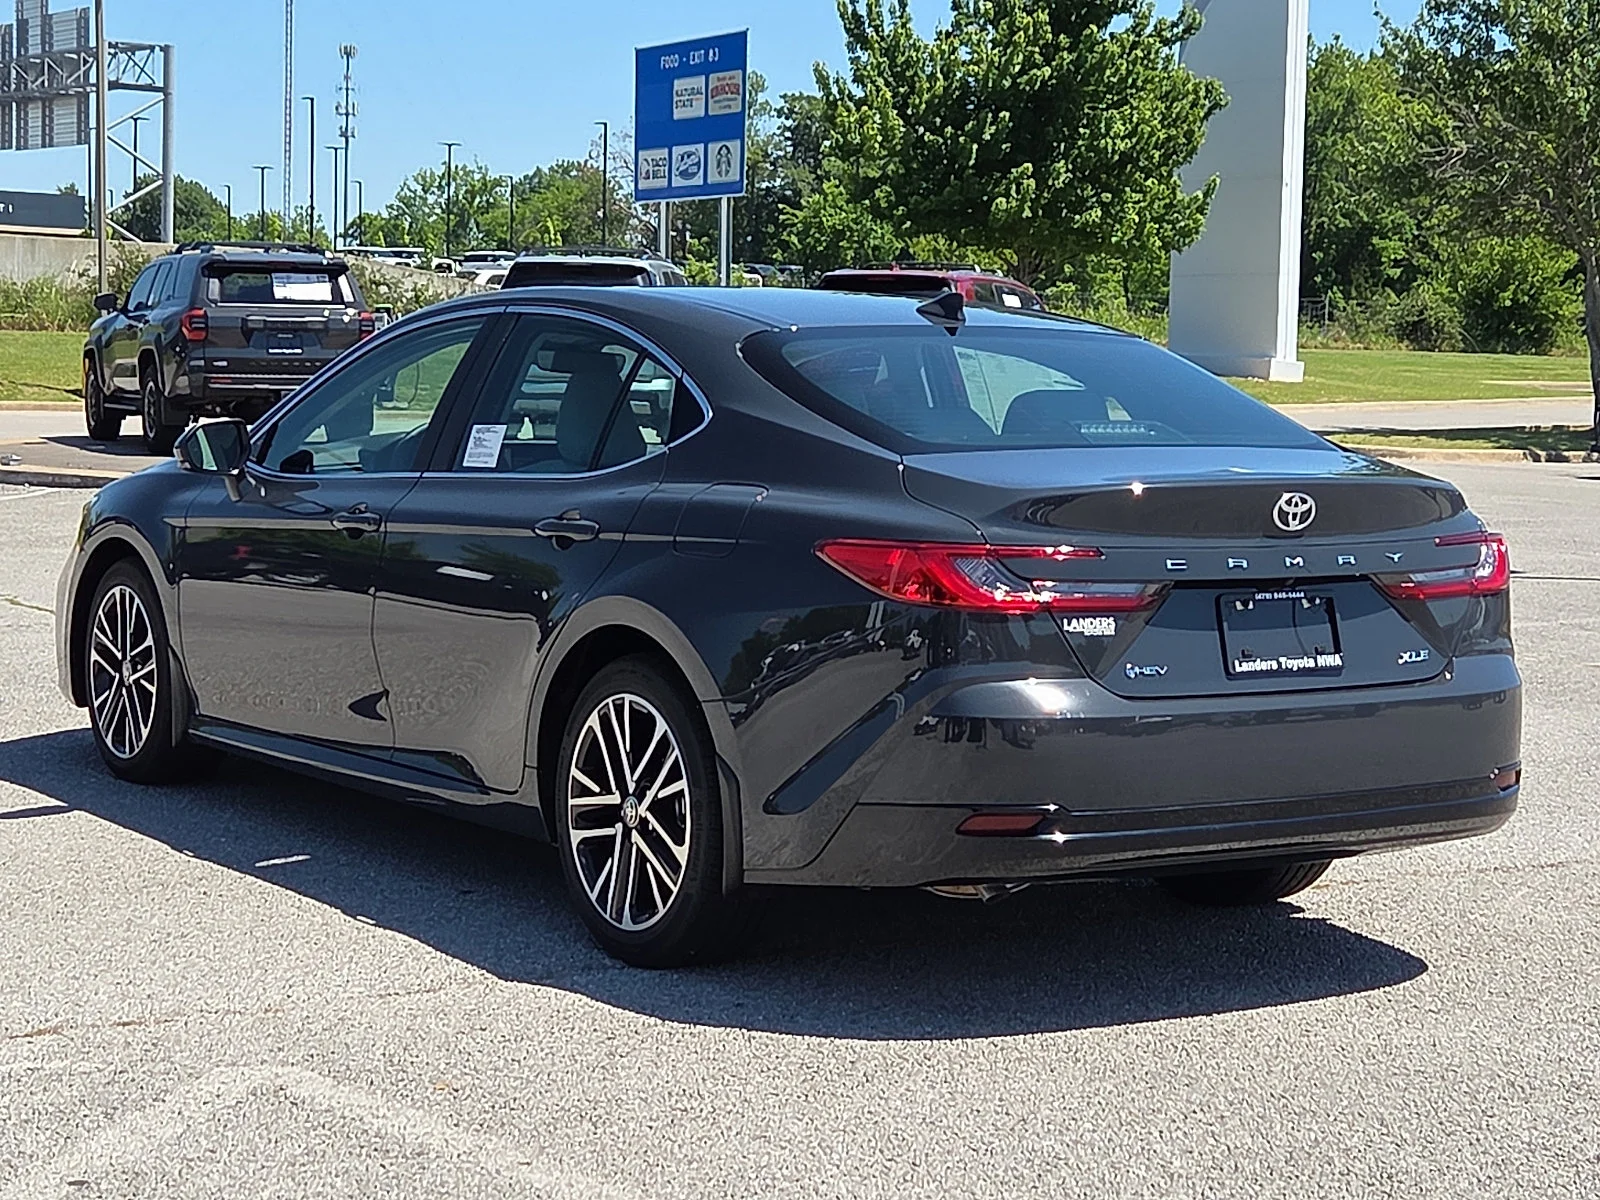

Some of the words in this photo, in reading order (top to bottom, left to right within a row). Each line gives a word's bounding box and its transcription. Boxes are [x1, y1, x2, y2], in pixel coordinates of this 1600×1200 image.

[661, 54, 679, 70] FOOD
[690, 50, 705, 65] EXIT
[675, 86, 703, 97] NATURAL
[675, 98, 694, 110] STATE
[651, 157, 667, 168] TACO
[652, 168, 667, 179] BELL
[1166, 552, 1403, 570] CAMRY
[1063, 617, 1115, 632] LANDERS
[1234, 658, 1278, 673] Landers
[1279, 656, 1315, 671] Toyota
[1316, 654, 1343, 668] NWA
[1397, 649, 1429, 665] XLE
